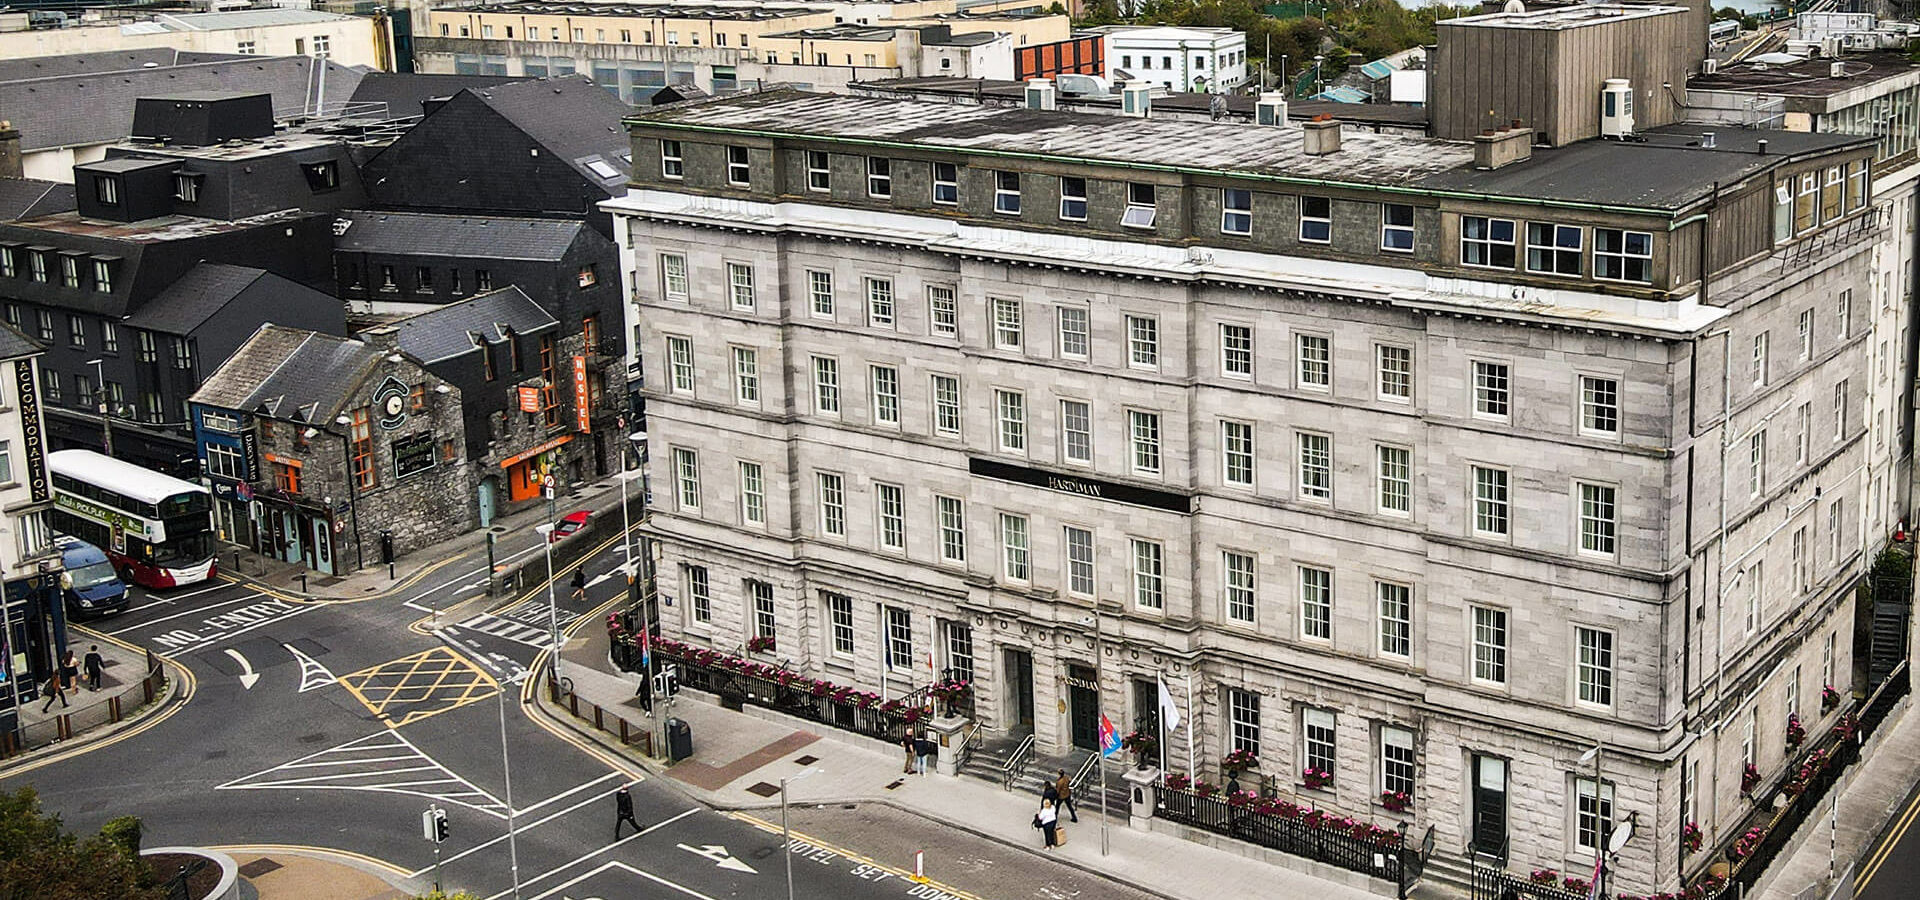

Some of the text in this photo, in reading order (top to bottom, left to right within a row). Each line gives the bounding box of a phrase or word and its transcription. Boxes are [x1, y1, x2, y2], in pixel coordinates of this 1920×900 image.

[575, 359, 587, 430] HOSTEL
[19, 361, 46, 500] ACCOMMODATION
[1048, 476, 1101, 496] HARDIMAN
[151, 598, 293, 648] NO ENTRY
[780, 839, 838, 865] HOTEL
[850, 864, 894, 883] SET
